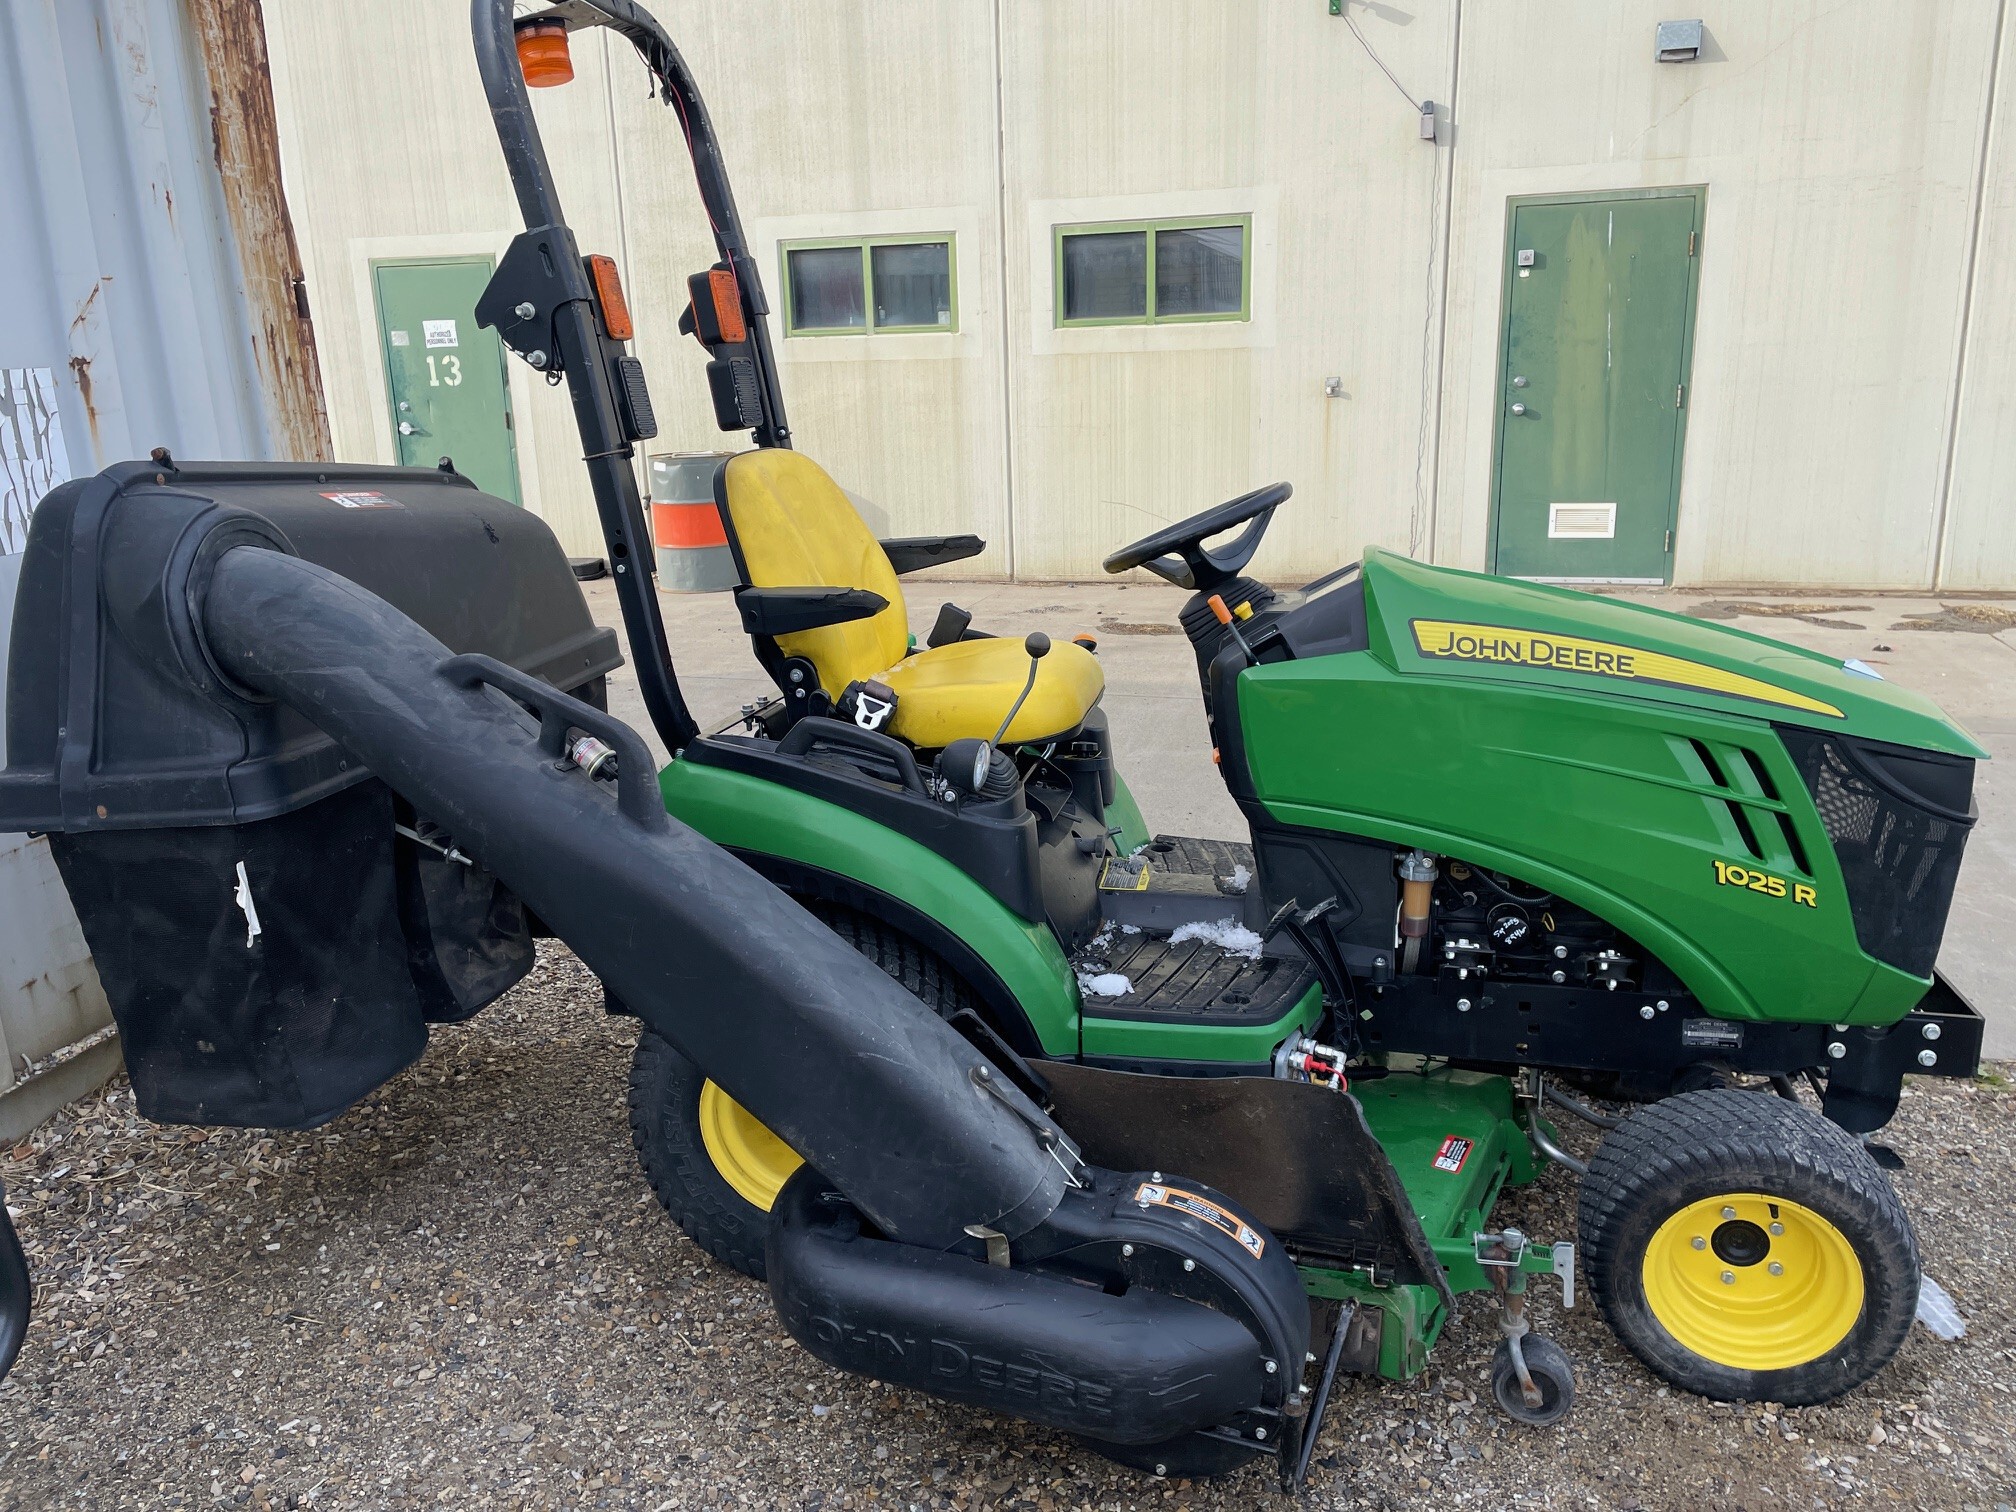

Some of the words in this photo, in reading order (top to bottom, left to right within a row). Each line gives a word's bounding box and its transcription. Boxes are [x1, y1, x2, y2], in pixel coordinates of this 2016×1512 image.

[426, 355, 463, 387] 13
[1438, 631, 1521, 660] JOHN
[1530, 639, 1635, 675] DEERE
[1712, 860, 1787, 898] 1025
[1793, 883, 1817, 908] R
